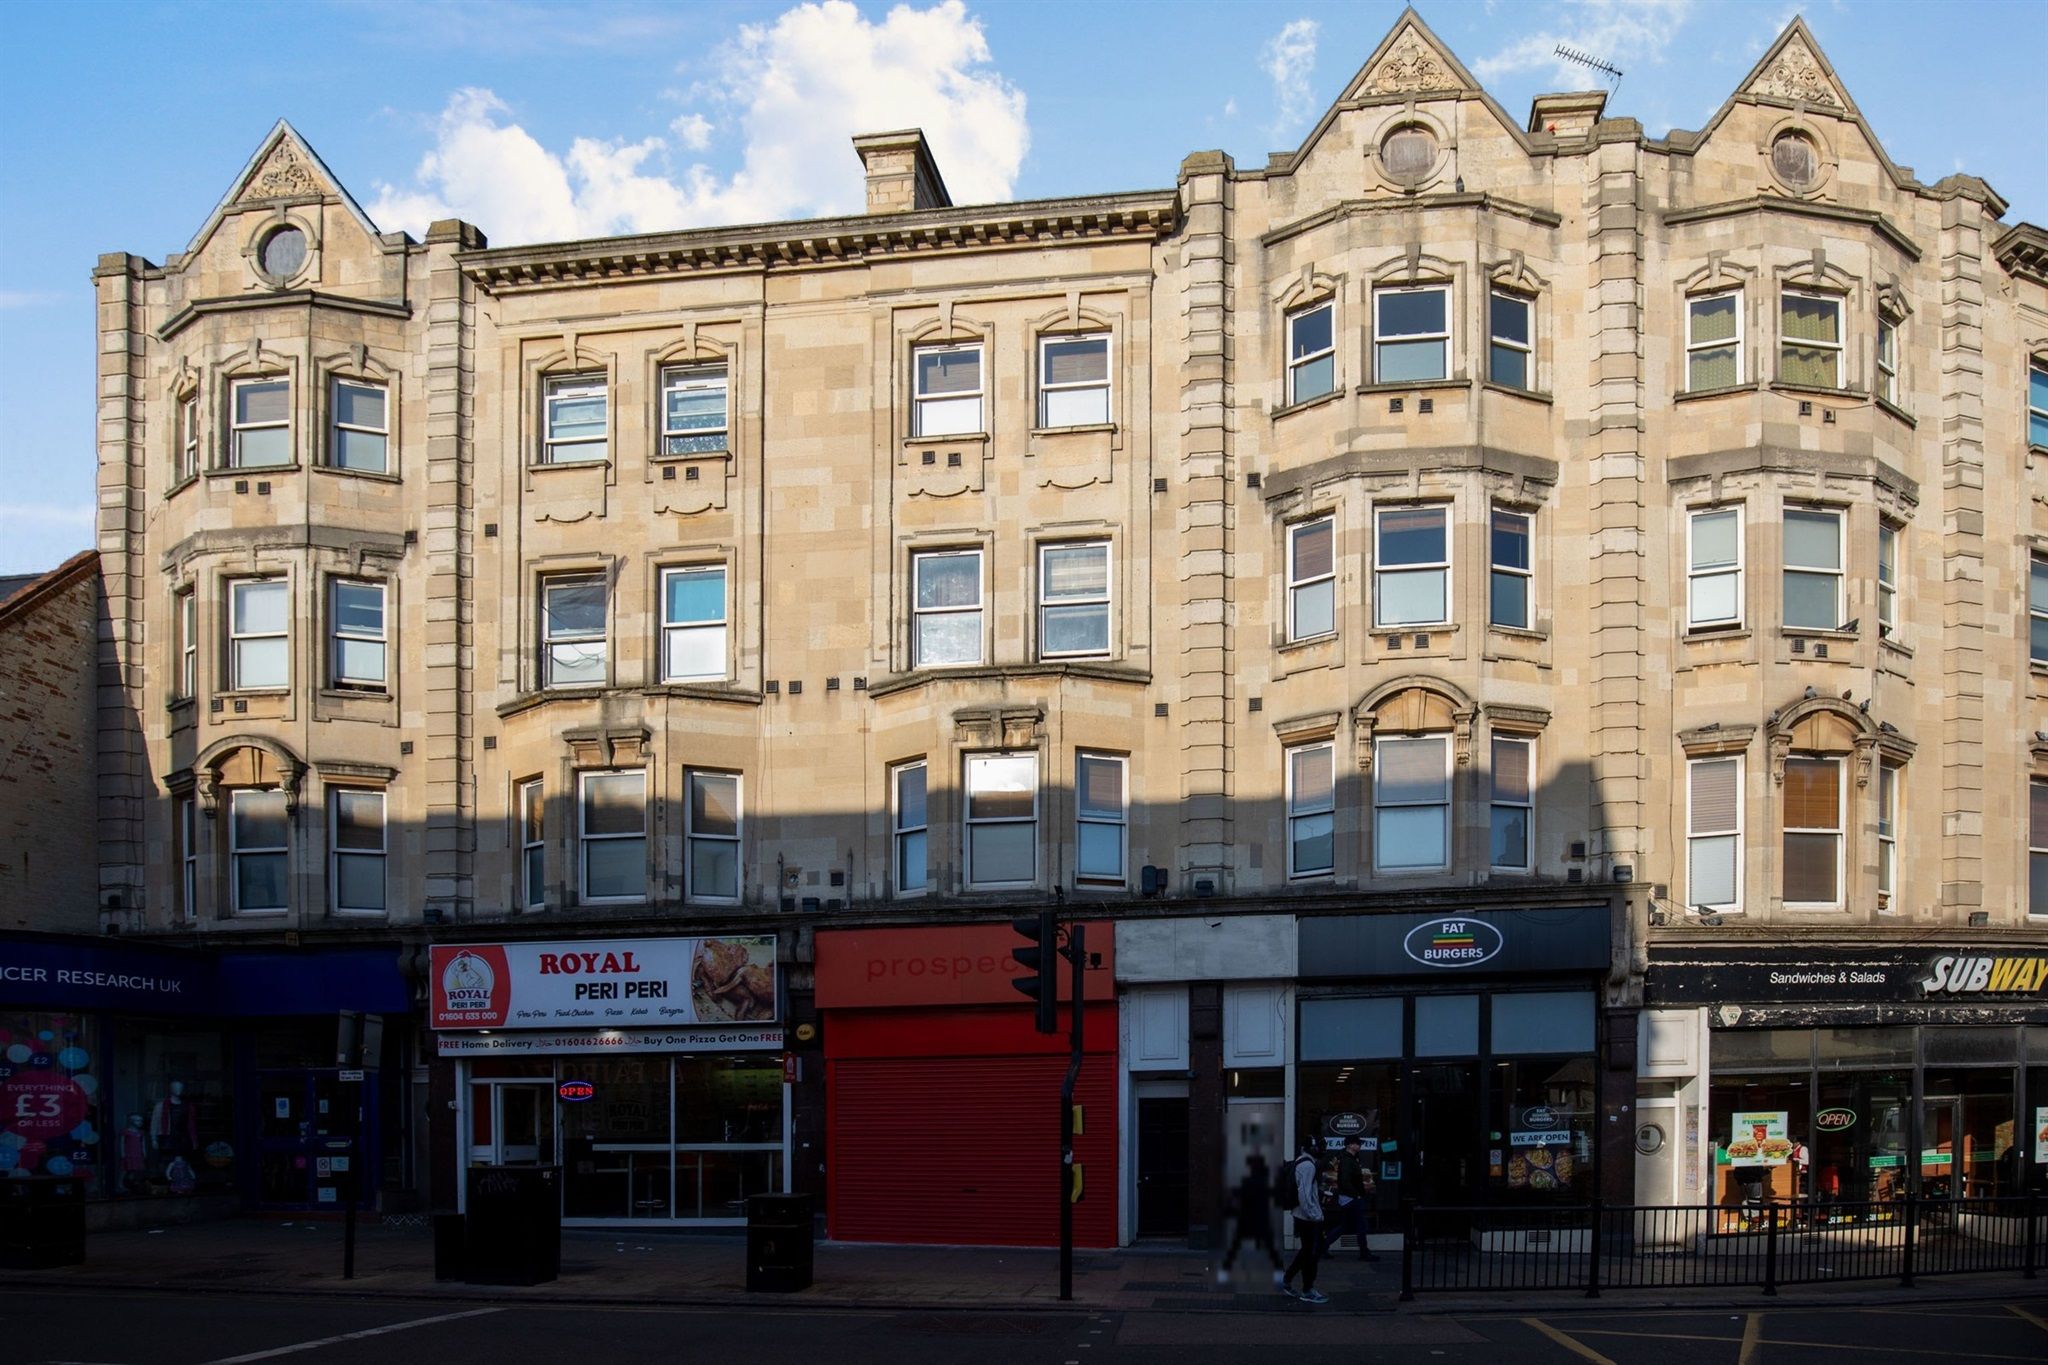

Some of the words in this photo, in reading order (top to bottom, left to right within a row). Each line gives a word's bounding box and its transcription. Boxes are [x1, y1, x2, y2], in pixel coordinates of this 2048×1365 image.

[1442, 922, 1466, 934] FAT
[1424, 947, 1484, 960] BURGERS
[539, 951, 640, 974] ROYAL
[867, 955, 1031, 982] prospec
[0, 966, 48, 982] CER
[57, 969, 155, 990] RESEARCH
[159, 979, 182, 993] UK
[1769, 971, 1836, 984] Sandwiches
[1838, 972, 1847, 984] &
[1849, 971, 1886, 984] Salads
[1921, 956, 2048, 993] SUBWAY
[448, 989, 490, 1000] ROYAL
[575, 982, 618, 1001] PERI
[624, 980, 668, 999] PERI
[451, 1001, 468, 1009] PERI
[469, 1001, 486, 1009] PERI
[481, 1011, 498, 1020] 000
[554, 1008, 571, 1018] Fried
[571, 1008, 594, 1018] Chicken
[604, 1008, 624, 1017] Pizza
[658, 1006, 684, 1018] Burgers
[439, 1040, 460, 1049] FREE
[462, 1040, 490, 1049] Home
[492, 1039, 532, 1049] Delivery
[555, 1037, 624, 1047] 01604626666
[644, 1036, 662, 1046] Buy
[665, 1035, 686, 1044] One
[689, 1034, 716, 1043] Pizza
[718, 1034, 737, 1043] Get
[738, 1033, 759, 1042] One
[760, 1033, 783, 1042] FREE
[33, 1056, 49, 1065] £2
[7, 1083, 75, 1092] EVERYTHING
[559, 1085, 594, 1097] OPEN
[15, 1093, 61, 1118] £3
[609, 1103, 650, 1118] ROYAL
[17, 1119, 33, 1128] OR
[36, 1119, 61, 1127] LESS
[1818, 1113, 1852, 1126] OPEN
[1528, 1134, 1543, 1142] ARE
[1545, 1133, 1569, 1141] OPEN
[72, 1151, 88, 1160] £2
